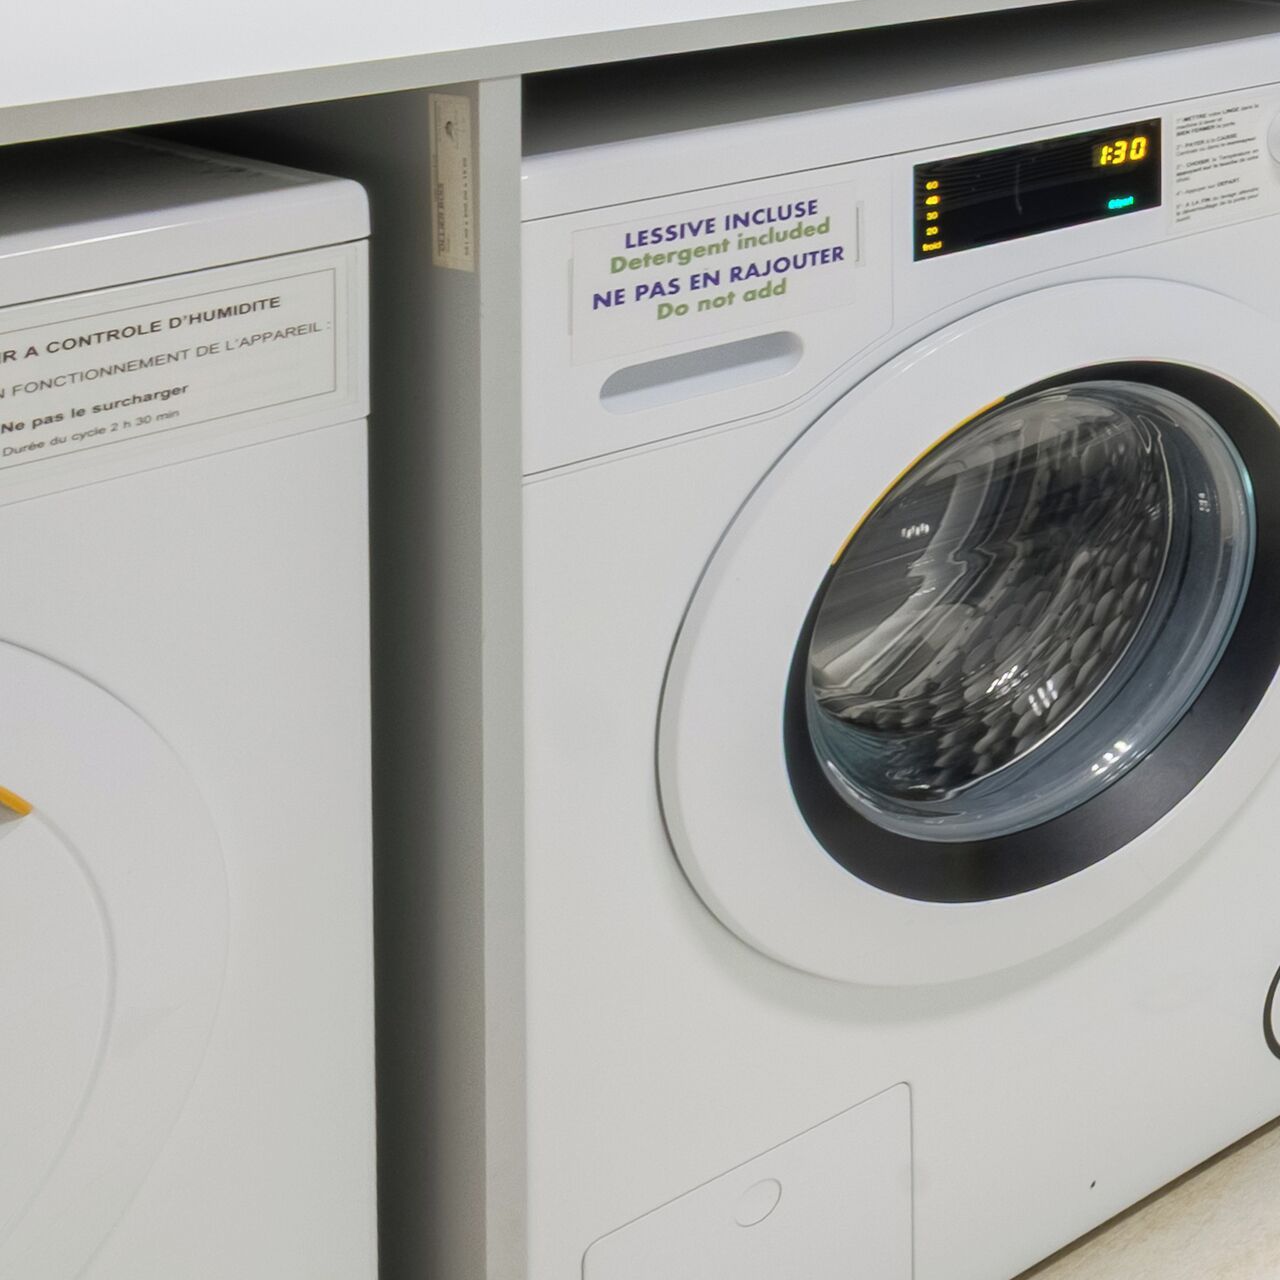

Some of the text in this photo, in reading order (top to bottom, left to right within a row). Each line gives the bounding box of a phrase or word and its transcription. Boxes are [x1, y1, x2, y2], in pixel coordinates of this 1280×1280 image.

[1100, 136, 1147, 166] 1:30
[610, 216, 831, 274] Detergent included
[625, 199, 818, 249] LESSIVE INCLUSE
[593, 245, 845, 310] NE PAS EN RAJOUTER
[657, 277, 787, 320] Do not add
[24, 345, 39, 359] A
[45, 320, 162, 354] CONTROLE
[168, 296, 282, 330] D'HUMIDITE
[12, 348, 191, 397] FONCTIONNEMENT
[196, 342, 221, 358] DE
[225, 321, 323, 352] L'APPAREIL
[1, 384, 189, 434] Ne pas le surcharger
[2, 408, 181, 458] Durée du cycle 2 h 30 min
